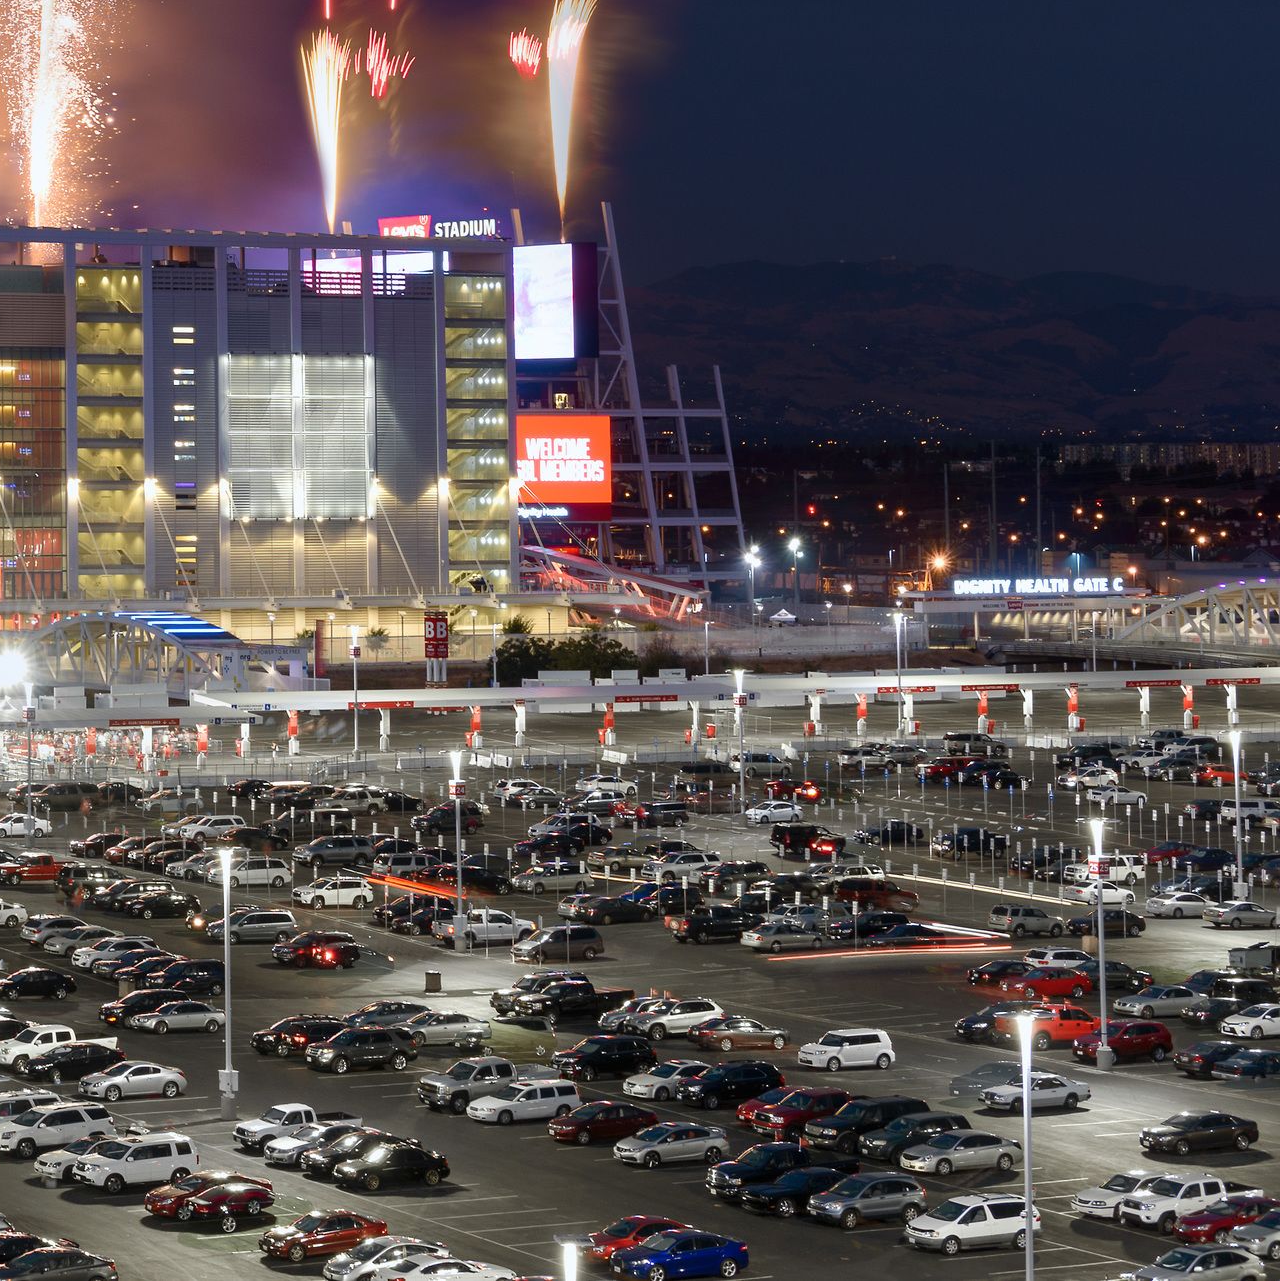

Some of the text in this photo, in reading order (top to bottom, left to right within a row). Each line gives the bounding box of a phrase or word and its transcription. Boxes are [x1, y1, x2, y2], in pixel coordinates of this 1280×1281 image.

[435, 219, 495, 238] STADIUM
[525, 438, 591, 460] WELCOME
[540, 460, 605, 482] MEMBERS
[543, 507, 569, 517] Health
[954, 577, 1123, 595] DIGNITY HEALTH GATE C
[425, 621, 434, 638] B
[436, 621, 447, 638] B
[1100, 864, 1109, 872] 25
